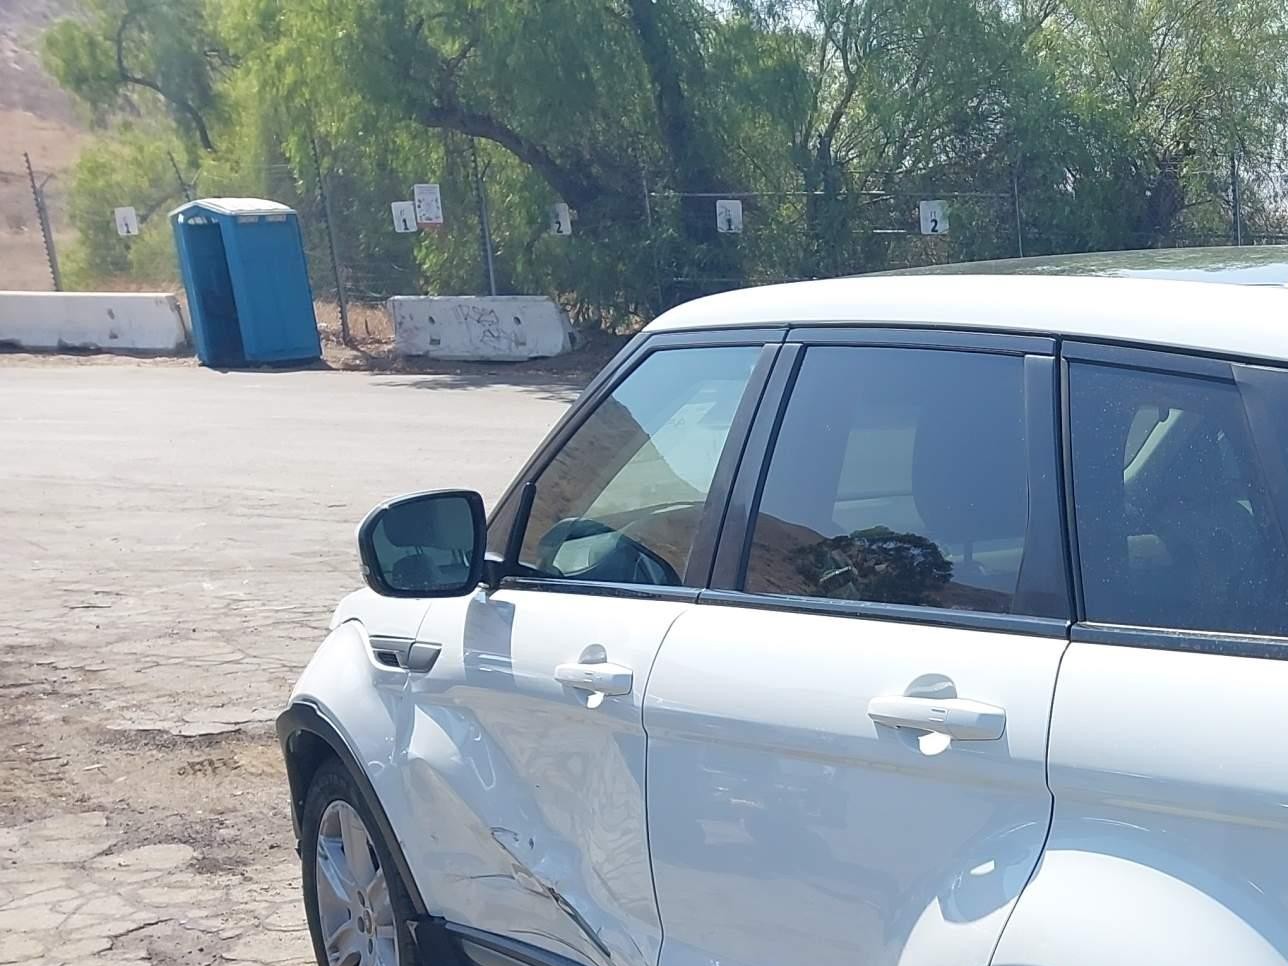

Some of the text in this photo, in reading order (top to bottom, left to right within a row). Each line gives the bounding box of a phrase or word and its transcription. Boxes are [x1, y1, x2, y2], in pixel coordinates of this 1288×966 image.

[402, 217, 410, 231] 1
[555, 220, 564, 233] 2
[930, 218, 939, 233] 2
